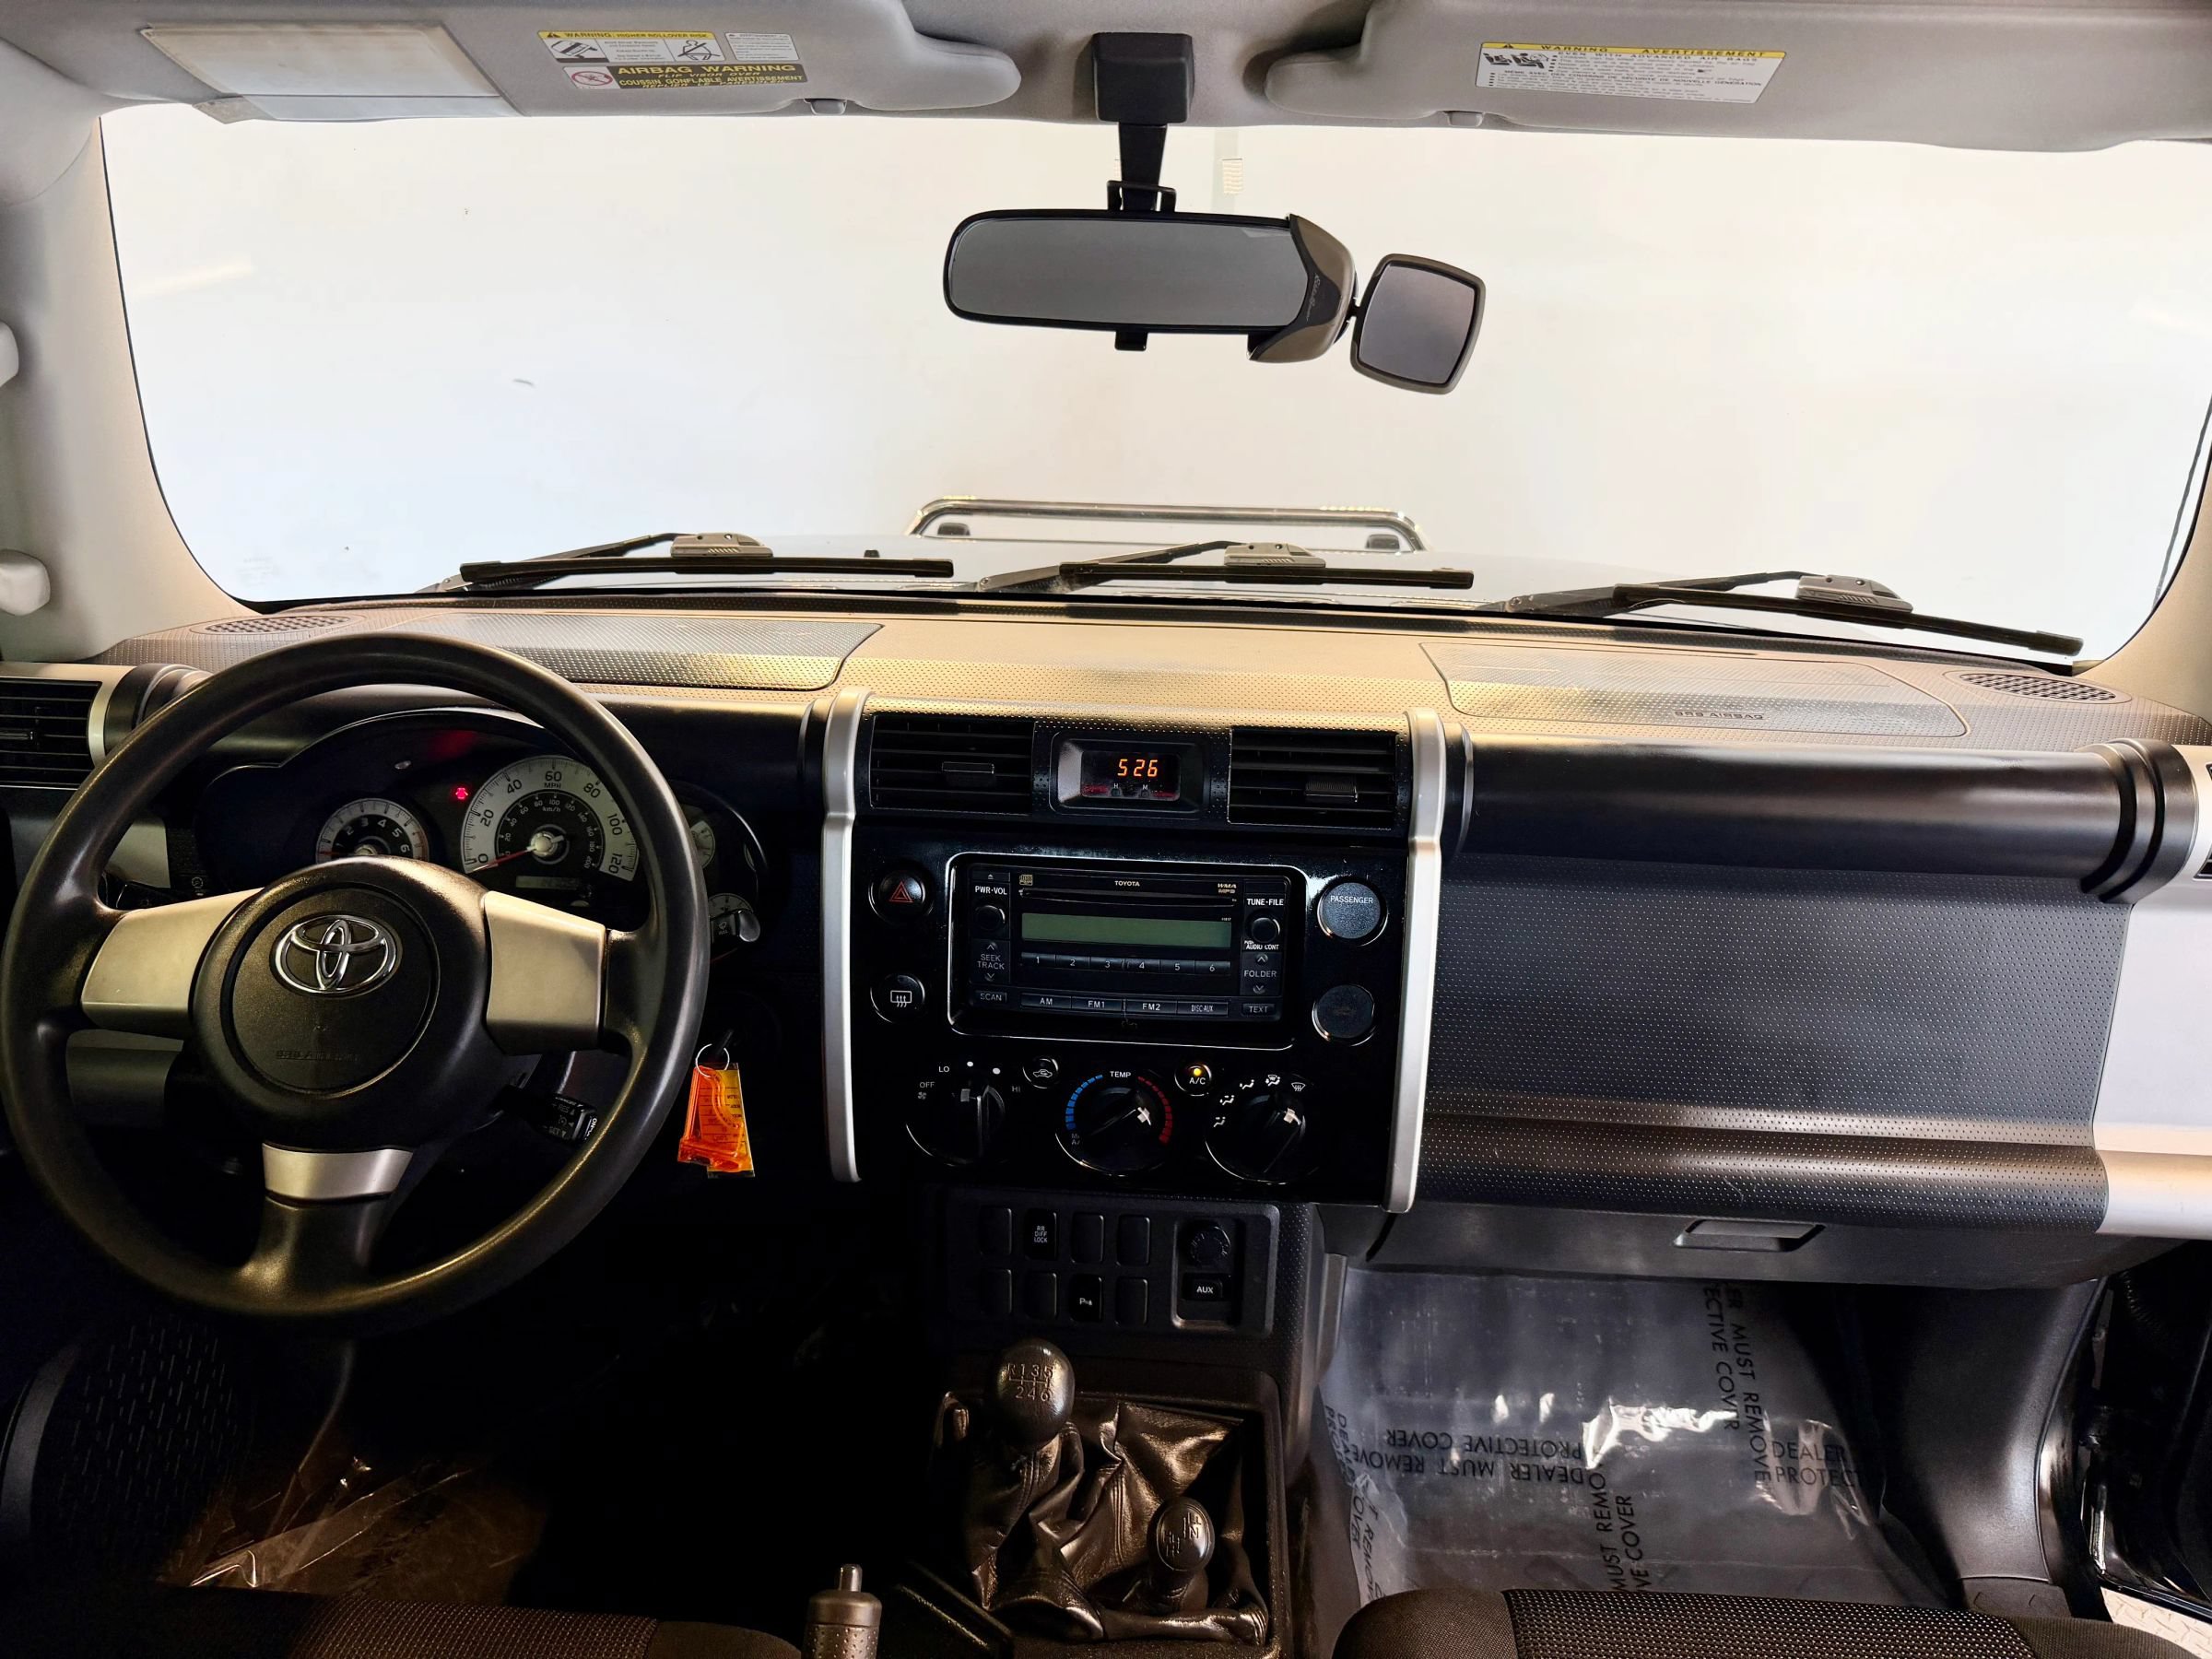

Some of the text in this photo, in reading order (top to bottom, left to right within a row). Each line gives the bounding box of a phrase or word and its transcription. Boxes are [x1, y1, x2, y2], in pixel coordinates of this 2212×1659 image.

[1641, 49, 1765, 57] AVERTISSEMENT
[618, 65, 796, 75] AIRBAG WARNING
[666, 76, 723, 85] GONFLABLE
[546, 771, 562, 782] 60
[507, 779, 523, 794] 40
[583, 782, 601, 798] 80
[480, 809, 494, 827] 20
[377, 818, 387, 829] 4
[607, 813, 623, 836] 100
[392, 828, 403, 838] 5
[400, 843, 411, 853] 6
[477, 853, 488, 864] 0
[608, 853, 623, 874] 120
[1330, 895, 1374, 904] PASSENGER
[980, 953, 1001, 961] SEEK
[1035, 956, 1041, 964] 1
[976, 960, 1005, 971] TRACK
[1070, 959, 1077, 967] 2
[1104, 960, 1111, 969] 3
[1138, 961, 1145, 970] 4
[1174, 963, 1181, 971] 5
[1209, 964, 1216, 972] 6
[980, 993, 1003, 1002] SCAN
[1040, 997, 1053, 1006] AM
[1088, 1000, 1106, 1008] FM1
[1142, 1003, 1161, 1011] FM2
[1248, 1006, 1268, 1014] TEXT
[1109, 1070, 1132, 1078] TEMP
[1189, 1077, 1206, 1085] A/C
[1011, 1085, 1021, 1093] HI
[1196, 1286, 1214, 1294] AUX
[1703, 1286, 1729, 1352] ECTIVE
[1731, 1322, 1756, 1380] MUST
[1020, 1363, 1026, 1376] 1
[1030, 1364, 1040, 1377] 3
[1015, 1385, 1051, 1402] 2 4 6
[1743, 1392, 1771, 1482] REMOVE
[1386, 1430, 1584, 1460] PROTECTIVE COVER
[1772, 1441, 1847, 1462] DEALER
[1352, 1444, 1584, 1484] DEALER MUST REMOVE
[1589, 1469, 1629, 1592] MUST REMO
[1616, 1495, 1643, 1560] COVER
